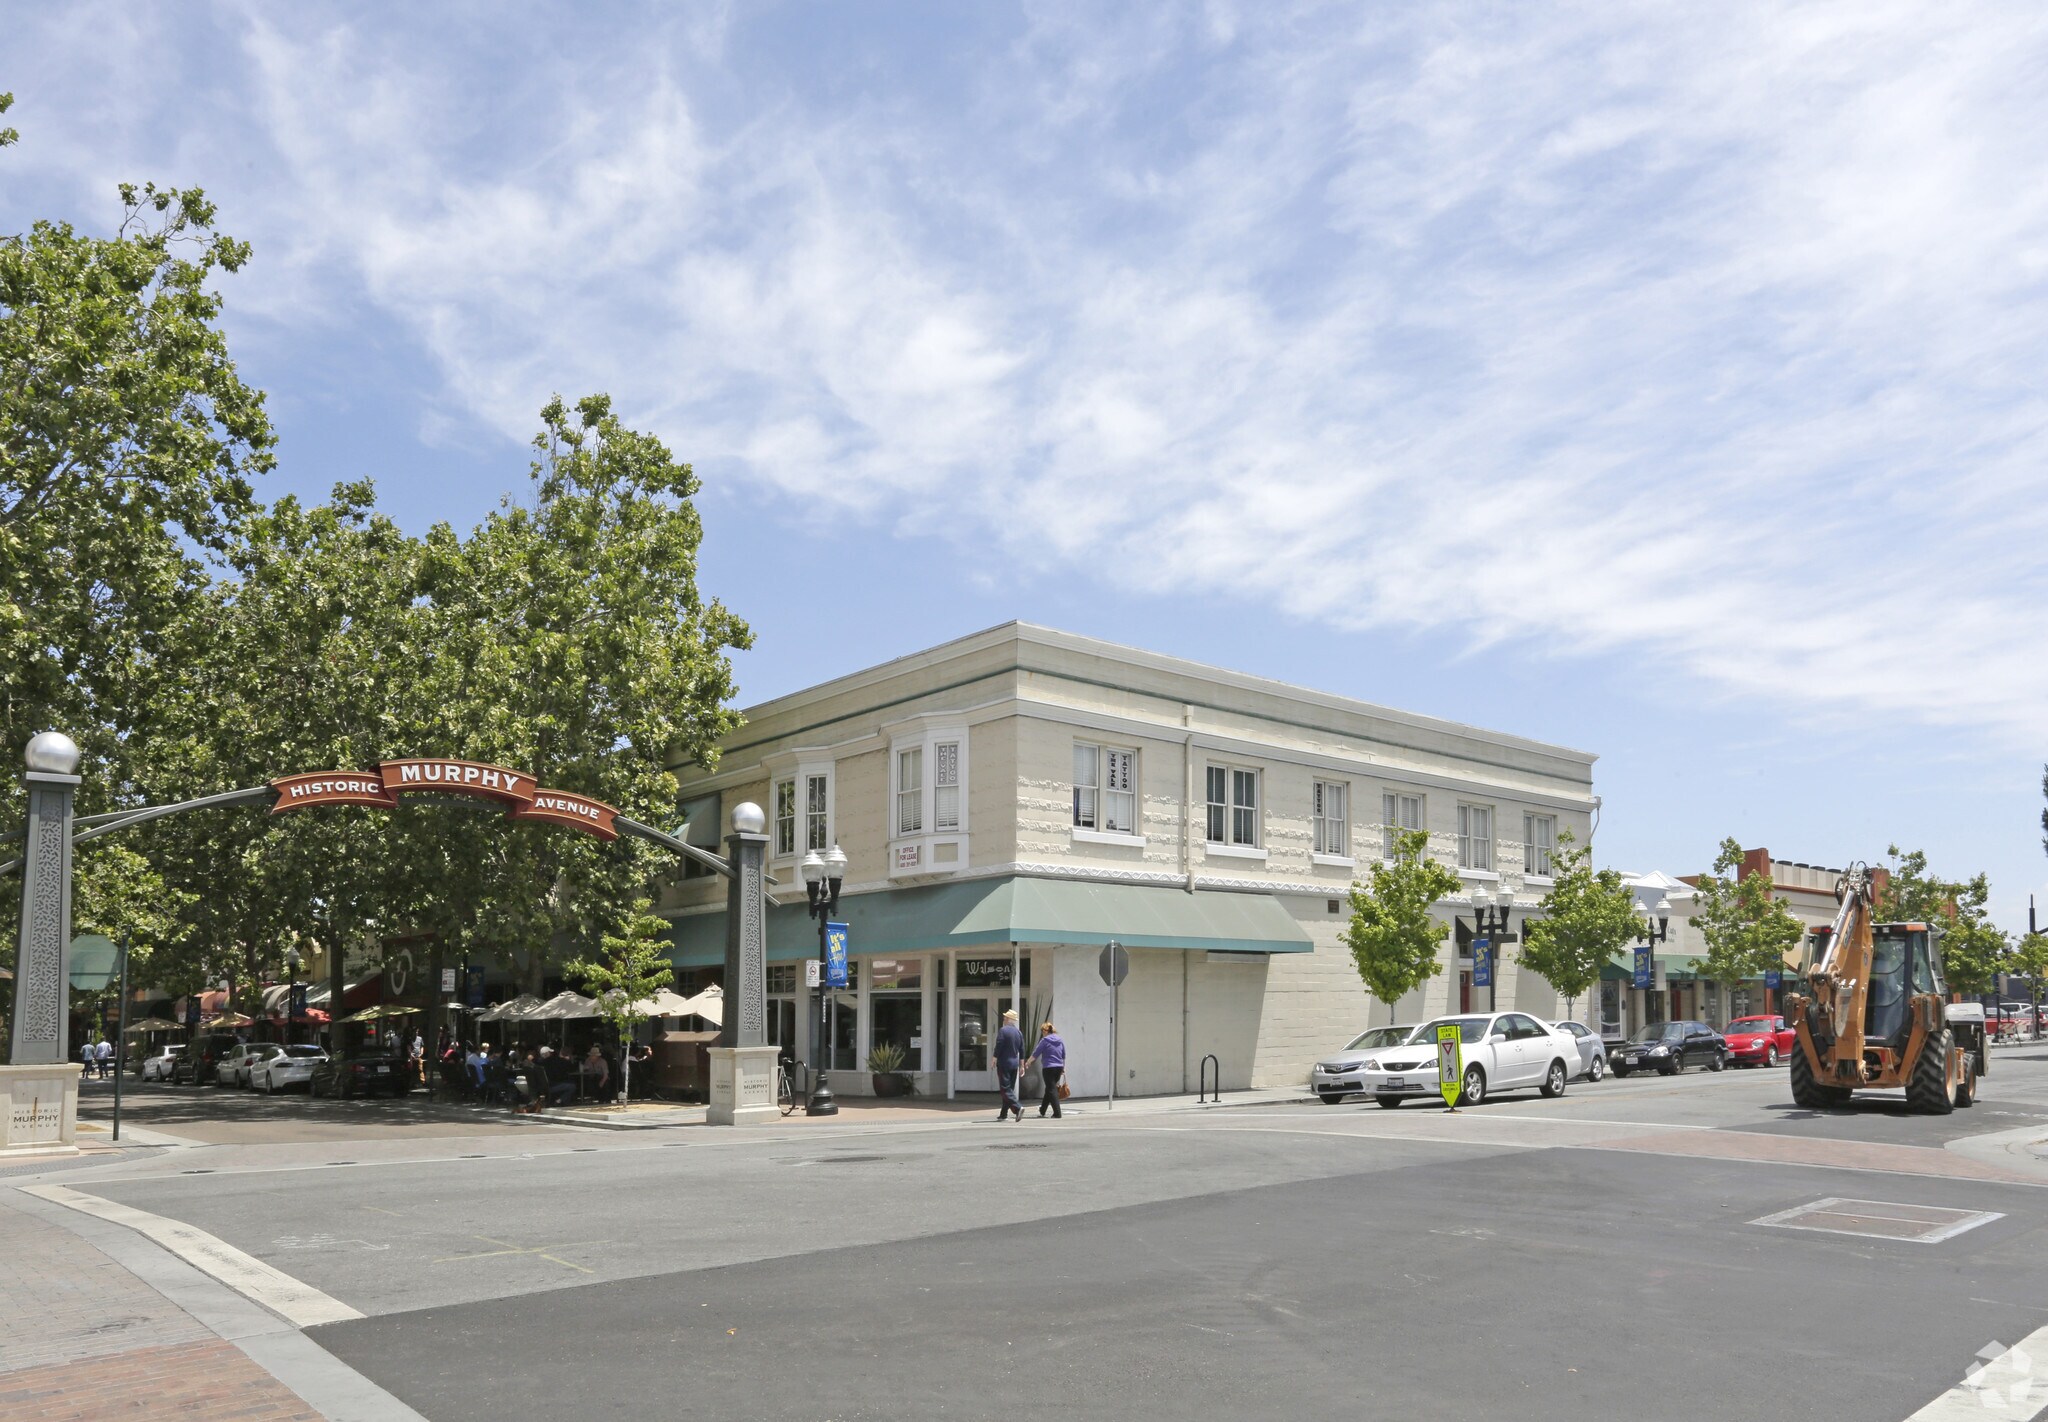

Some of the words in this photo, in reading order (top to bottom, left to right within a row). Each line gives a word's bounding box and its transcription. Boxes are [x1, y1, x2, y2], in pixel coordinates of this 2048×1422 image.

[290, 781, 379, 798] HISTORIC
[401, 765, 520, 791] MURPHY
[535, 798, 600, 819] AVENUE
[907, 852, 917, 860] LEASE
[830, 932, 845, 944] It's
[831, 941, 842, 953] all
[965, 961, 1013, 975] Wilson'
